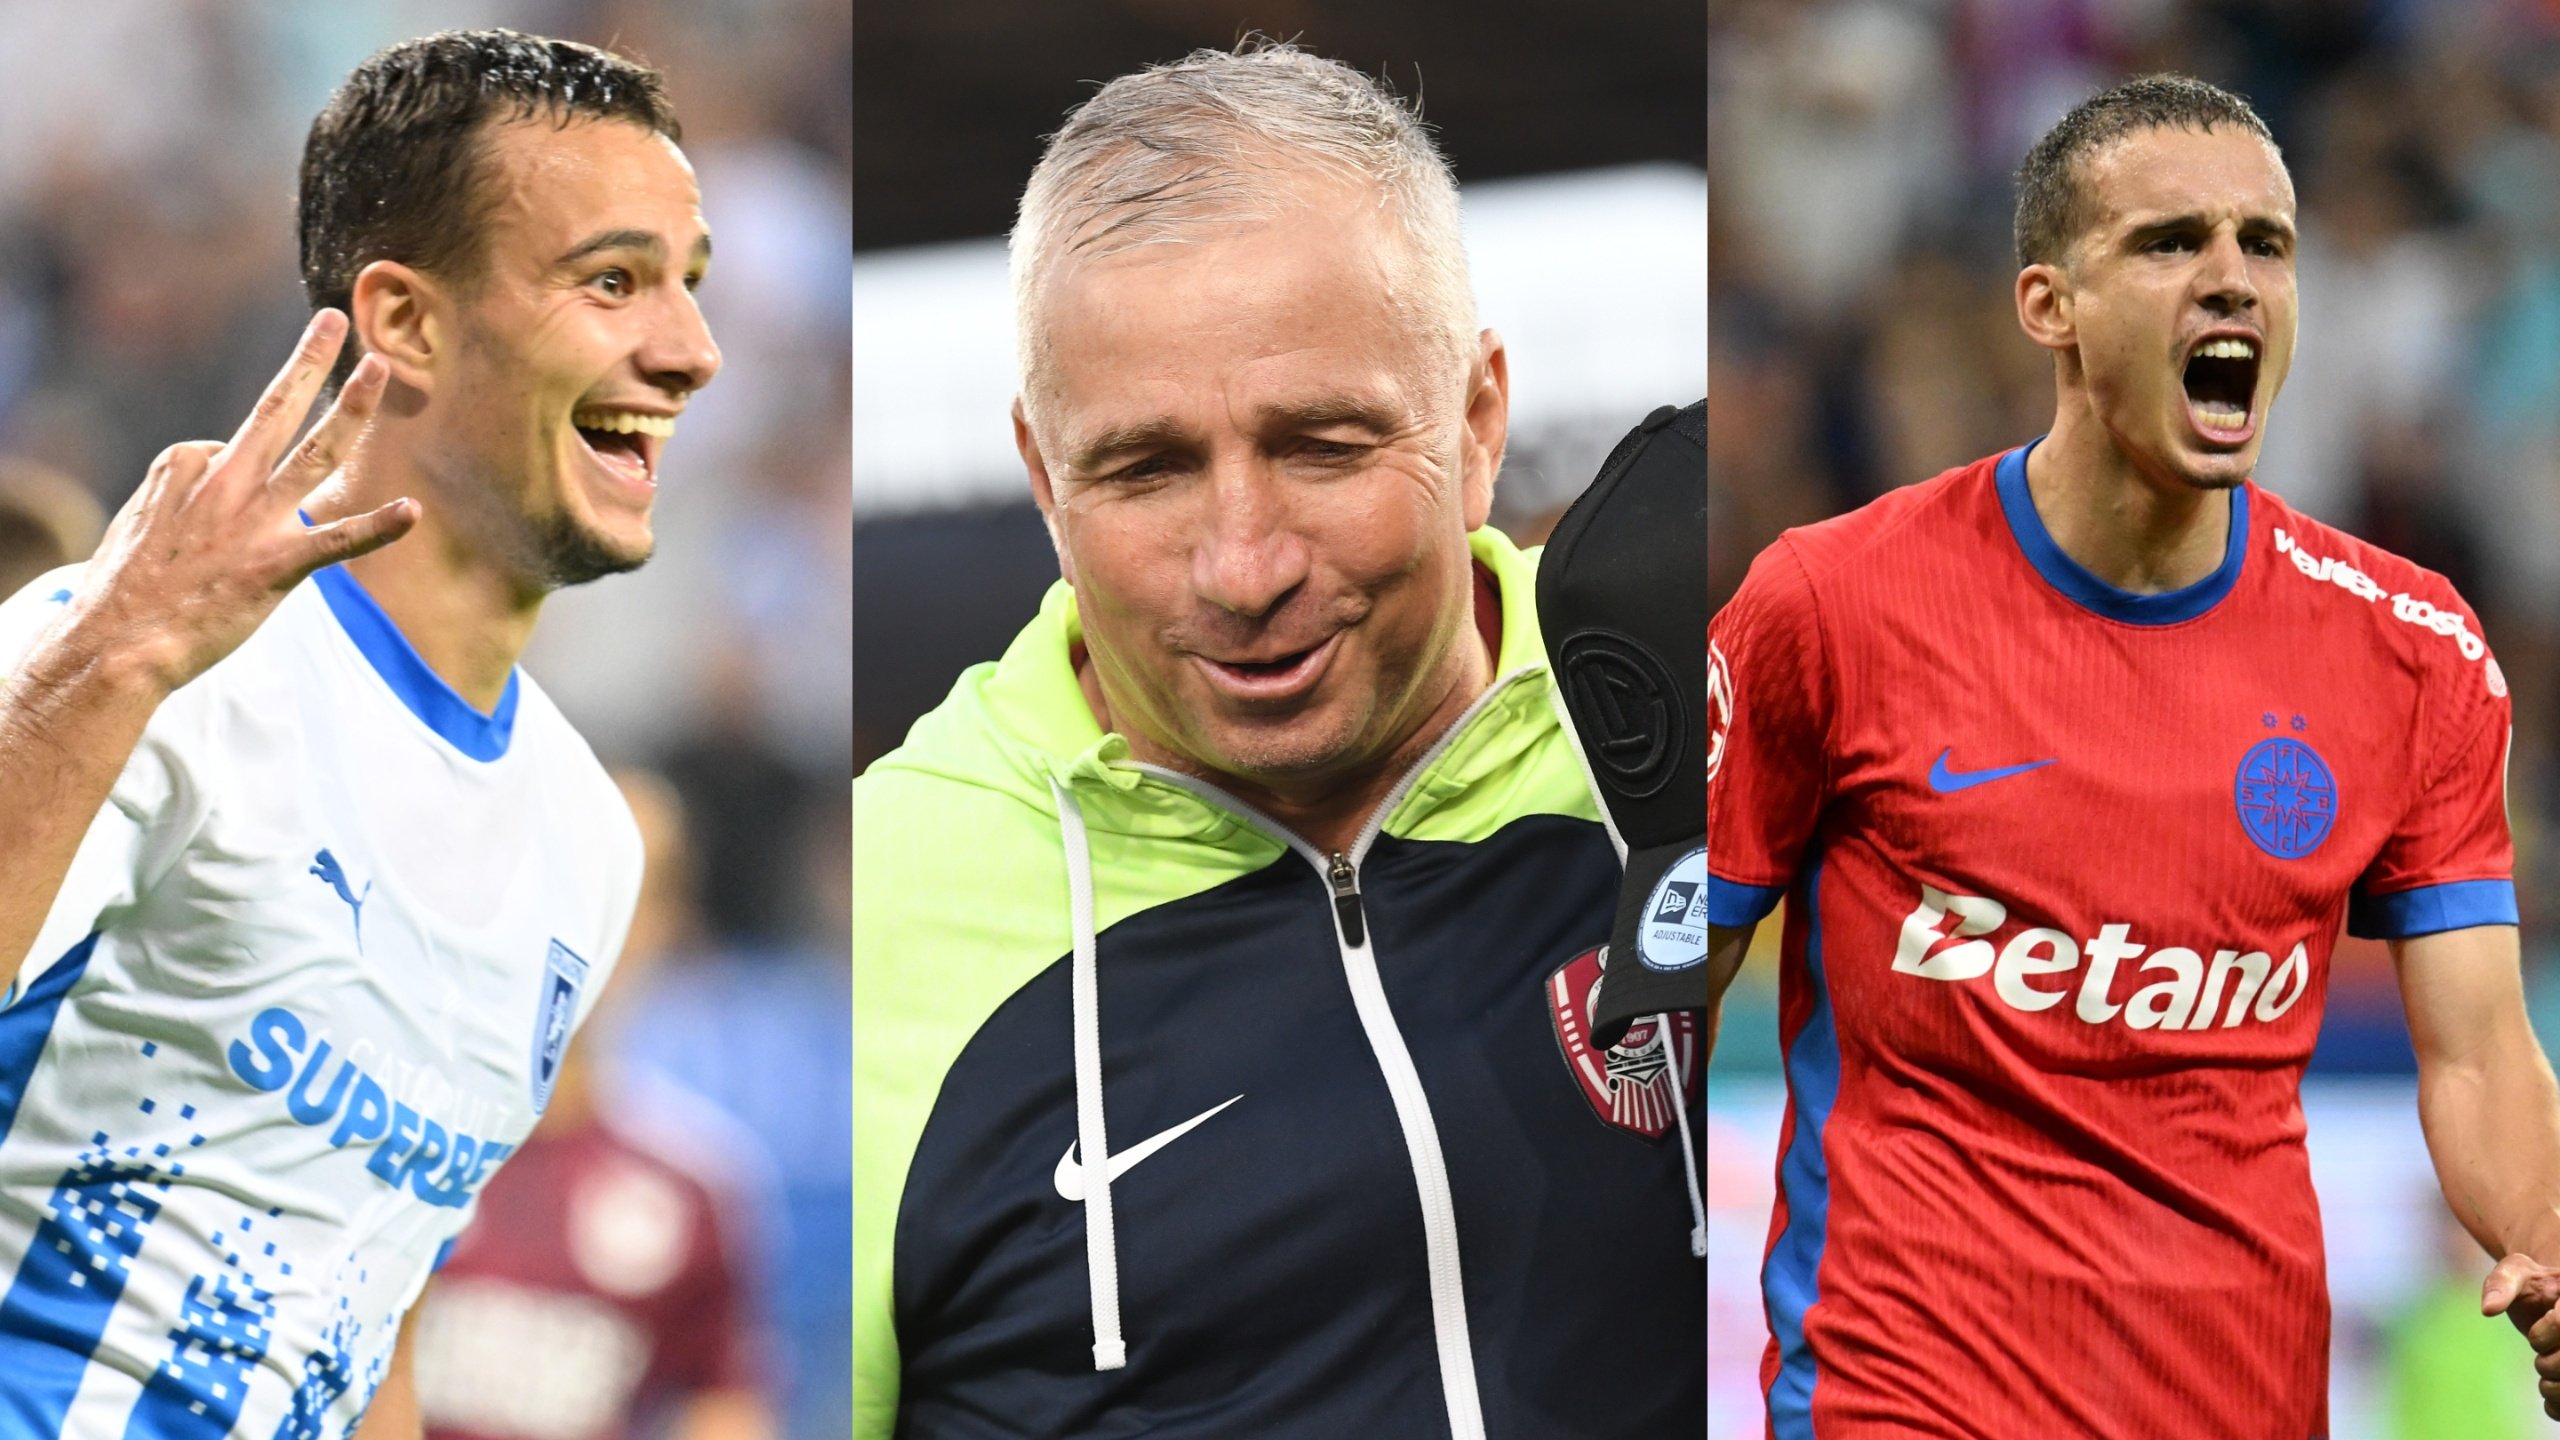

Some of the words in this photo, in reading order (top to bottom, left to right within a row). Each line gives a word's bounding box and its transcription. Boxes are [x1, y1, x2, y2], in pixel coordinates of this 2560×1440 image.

[2273, 527, 2389, 603] walter
[1653, 929, 1702, 946] ADJUSTABLE
[1891, 883, 2309, 1032] Betano
